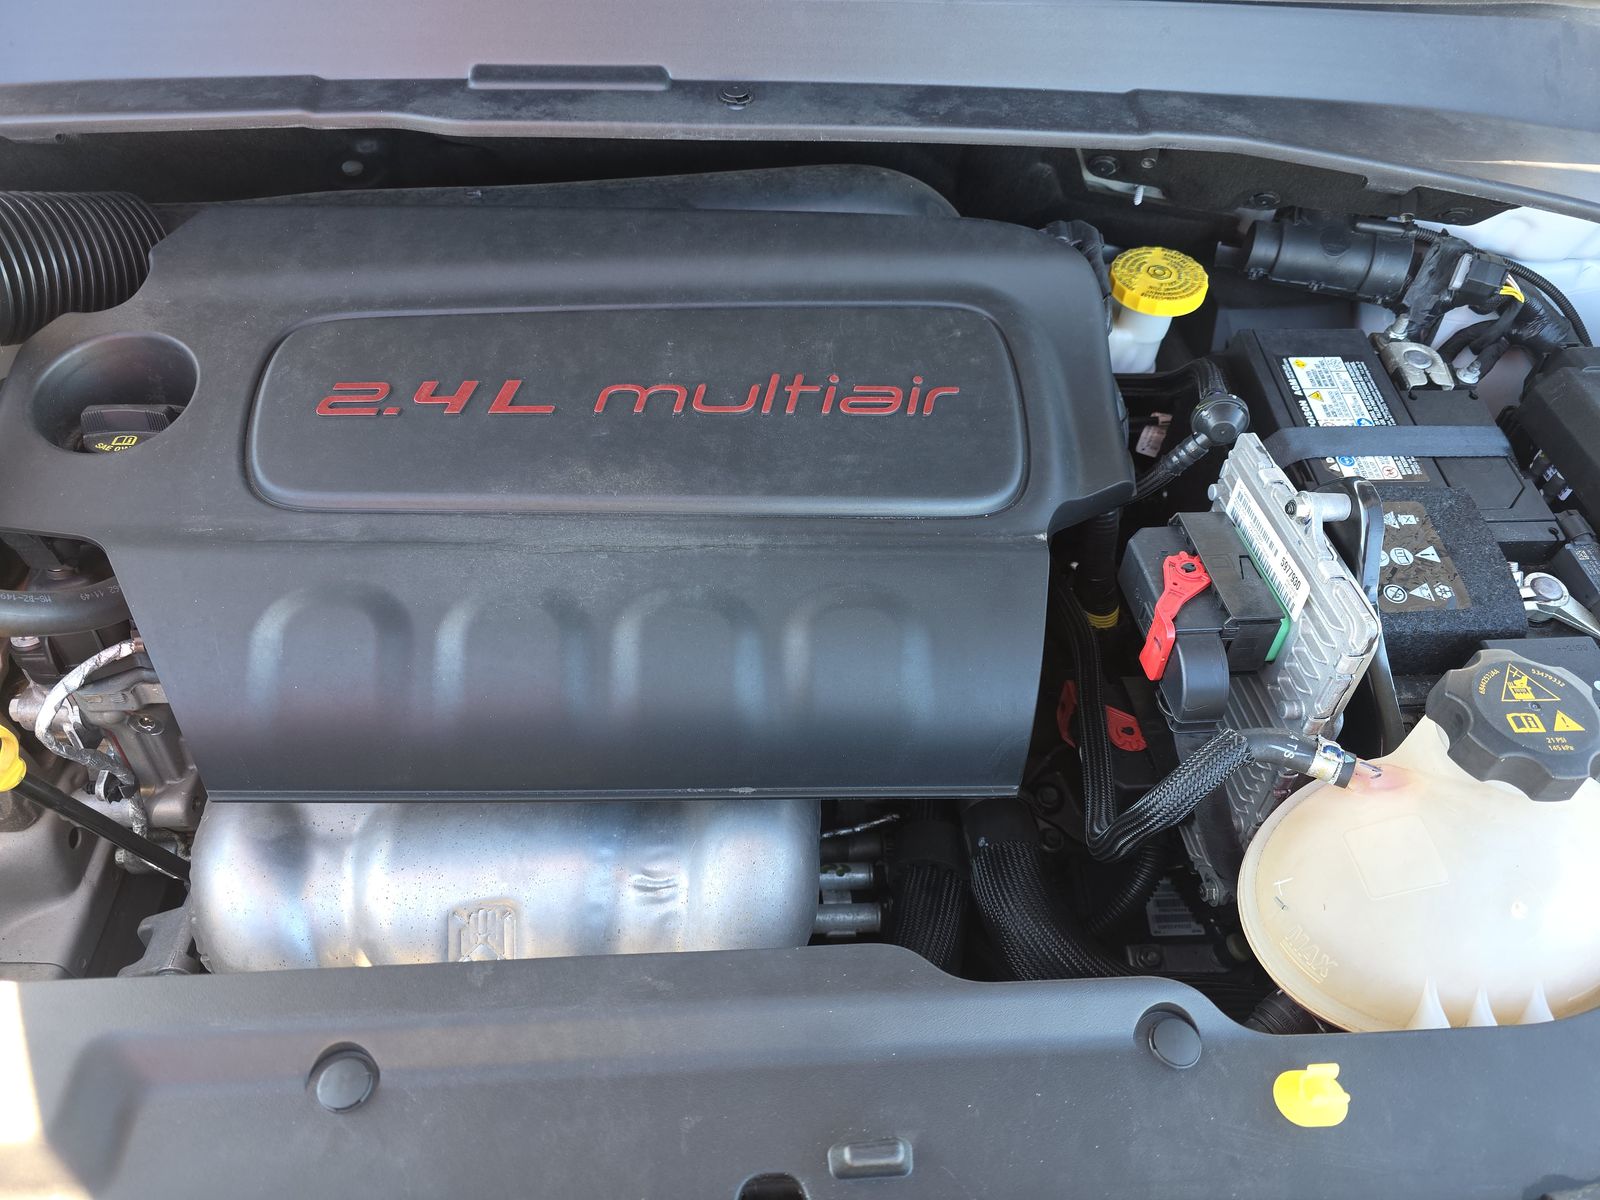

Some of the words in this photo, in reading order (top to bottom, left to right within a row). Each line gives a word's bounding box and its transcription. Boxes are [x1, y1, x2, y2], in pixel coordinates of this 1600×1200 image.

[592, 372, 961, 416] multiair
[95, 442, 113, 451] SAE
[1280, 556, 1302, 591] 5977930
[1282, 924, 1339, 979] MAX
